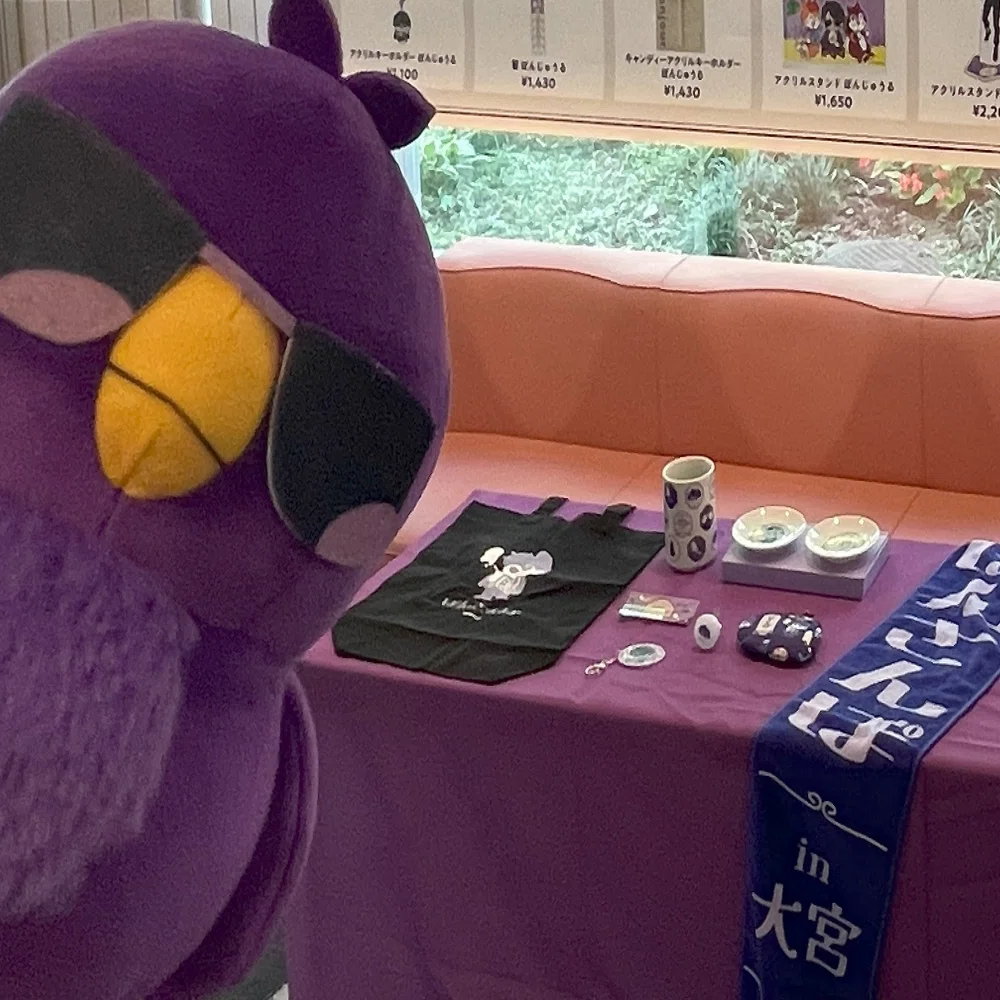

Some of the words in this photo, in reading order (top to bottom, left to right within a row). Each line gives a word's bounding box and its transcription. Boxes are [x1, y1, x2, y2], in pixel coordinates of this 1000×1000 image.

[521, 77, 556, 89] ¥1,430
[664, 85, 701, 99] ¥1,430
[815, 94, 853, 109] ¥1,650
[793, 838, 830, 885] in
[752, 882, 863, 978] 大宮
